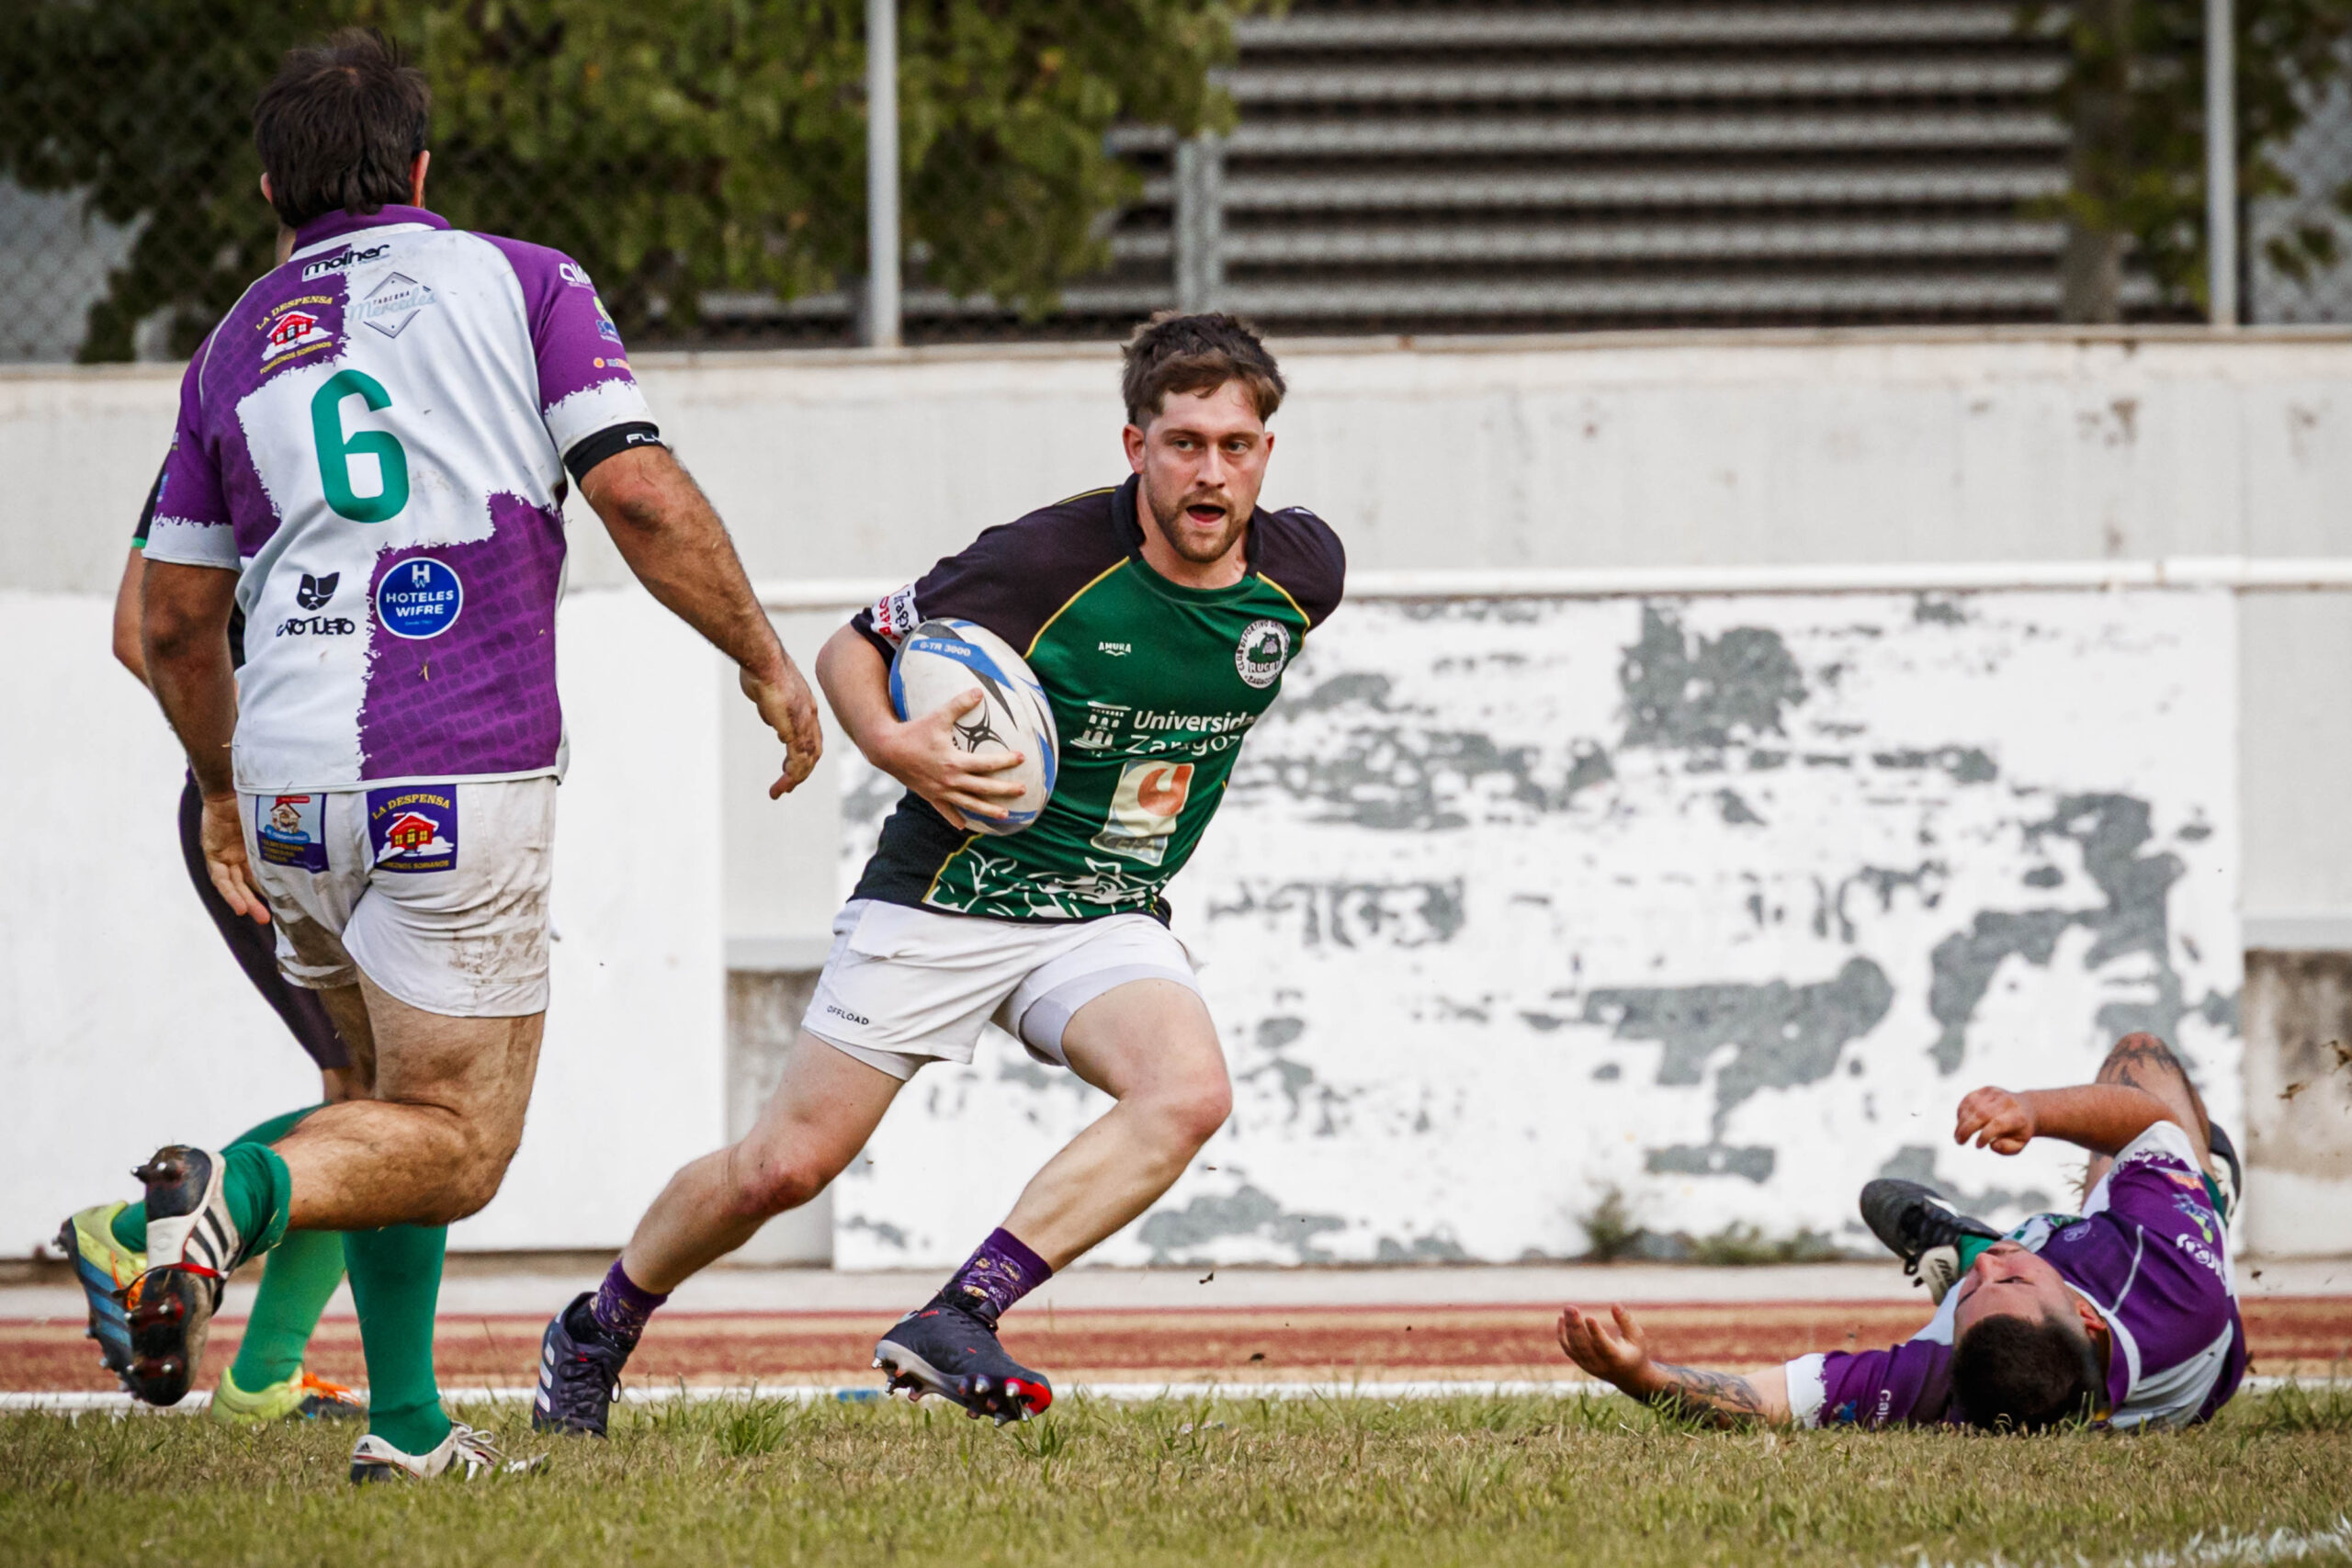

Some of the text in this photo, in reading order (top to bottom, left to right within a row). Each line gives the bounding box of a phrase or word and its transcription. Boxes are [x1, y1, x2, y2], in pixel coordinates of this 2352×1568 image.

[304, 244, 390, 276] molher
[255, 316, 271, 331] LA
[271, 295, 334, 317] DESPENSA
[311, 369, 410, 524] 6
[386, 590, 454, 604] HOTELES
[395, 604, 445, 617] WIFRE
[944, 644, 971, 657] 3000
[1098, 641, 1132, 653] AMURA
[371, 794, 450, 820] LA DESPENSA
[827, 1005, 869, 1026] OFFLOAD
